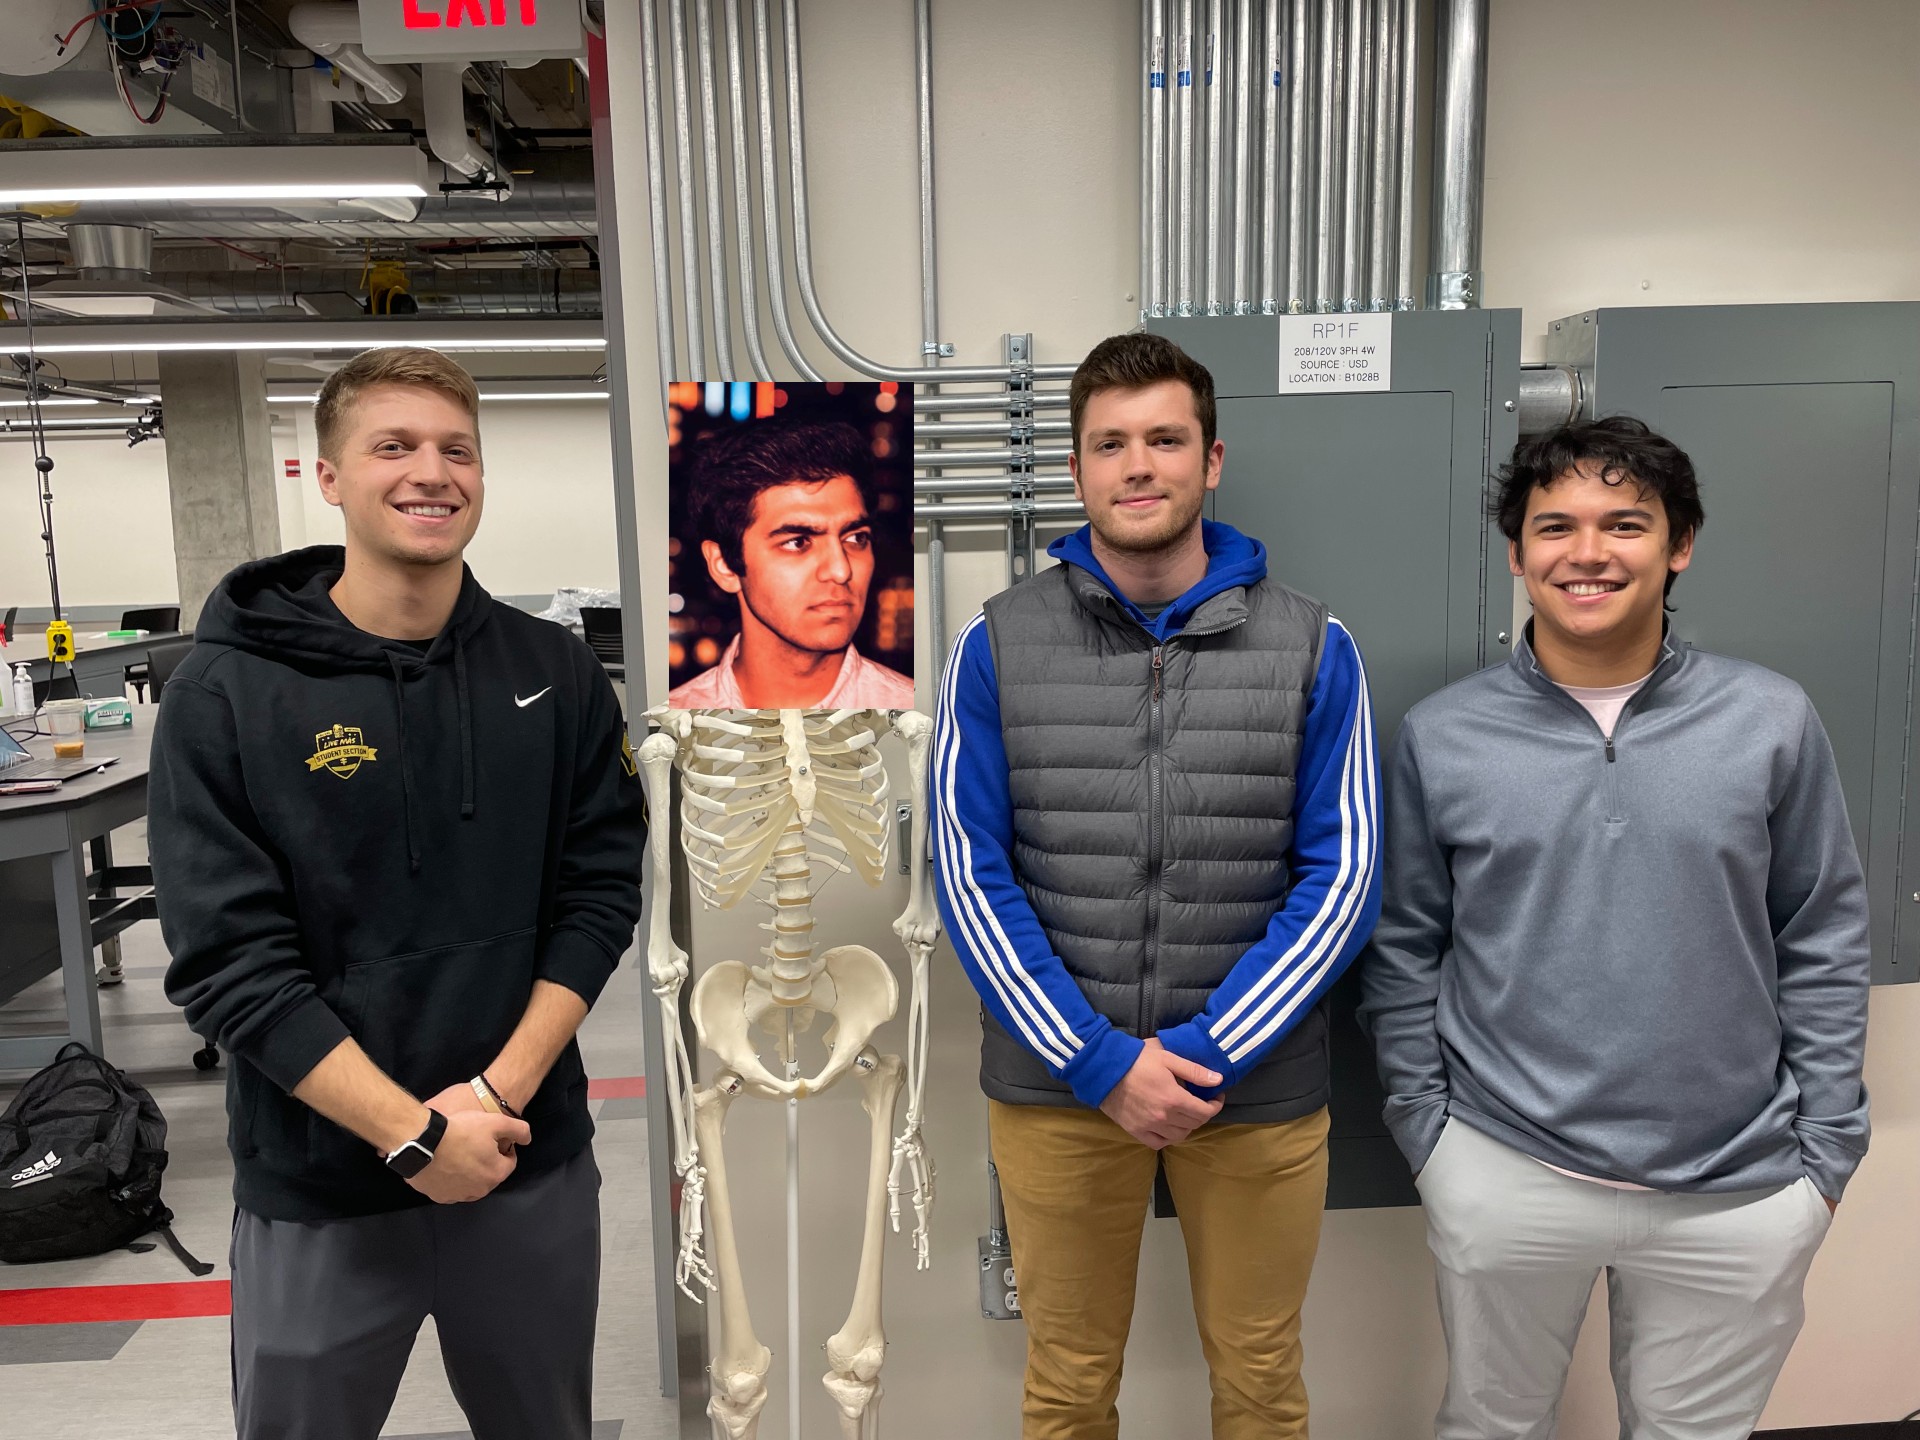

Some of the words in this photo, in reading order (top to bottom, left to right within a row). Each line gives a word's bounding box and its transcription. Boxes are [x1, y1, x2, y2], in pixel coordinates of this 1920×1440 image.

[1313, 322, 1359, 339] RP1F
[1294, 347, 1337, 356] 208/120V
[1339, 346, 1358, 355] 3PH
[1361, 345, 1375, 354] 4W
[1300, 360, 1340, 369] SOURCE
[1348, 359, 1368, 368] USD
[1289, 373, 1336, 383] LOCATION
[1344, 372, 1380, 382] B1028B
[323, 739, 339, 749] LIVE
[316, 750, 342, 762] STUDENT
[11, 1158, 62, 1181] adidas
